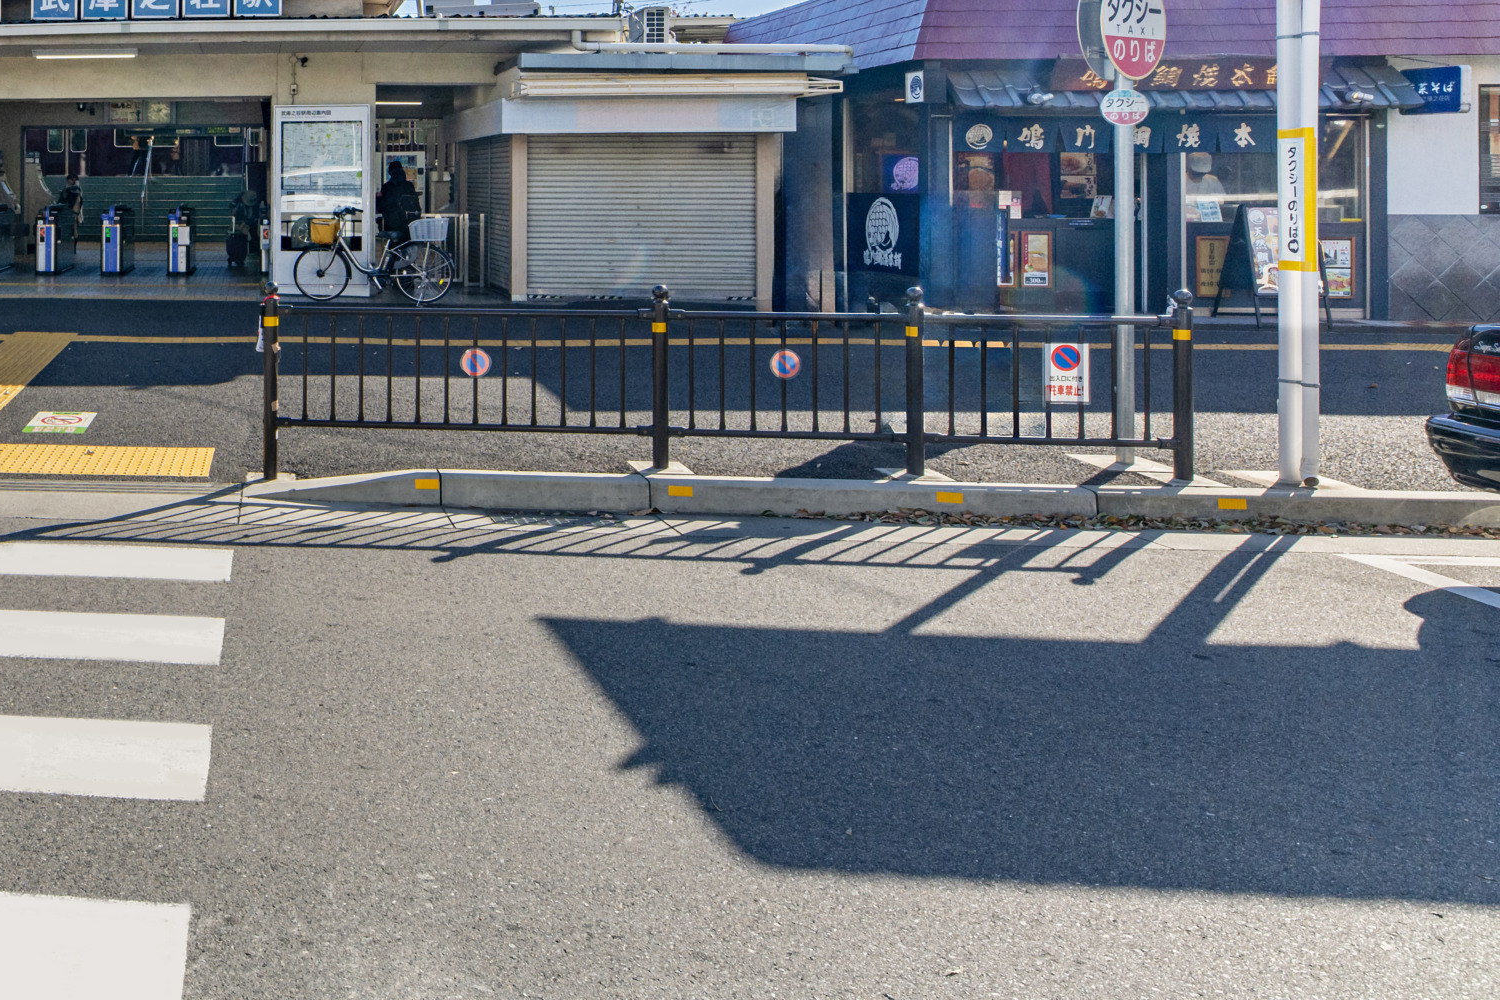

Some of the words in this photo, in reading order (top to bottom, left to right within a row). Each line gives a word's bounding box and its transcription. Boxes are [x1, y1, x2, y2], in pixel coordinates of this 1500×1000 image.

[1116, 23, 1155, 36] TAXI
[1113, 38, 1156, 63] のりば
[1411, 81, 1456, 95] 菜そば
[1106, 97, 1145, 108] タクシー
[1109, 112, 1144, 120] のりば
[1287, 146, 1299, 239] タクシーのりば
